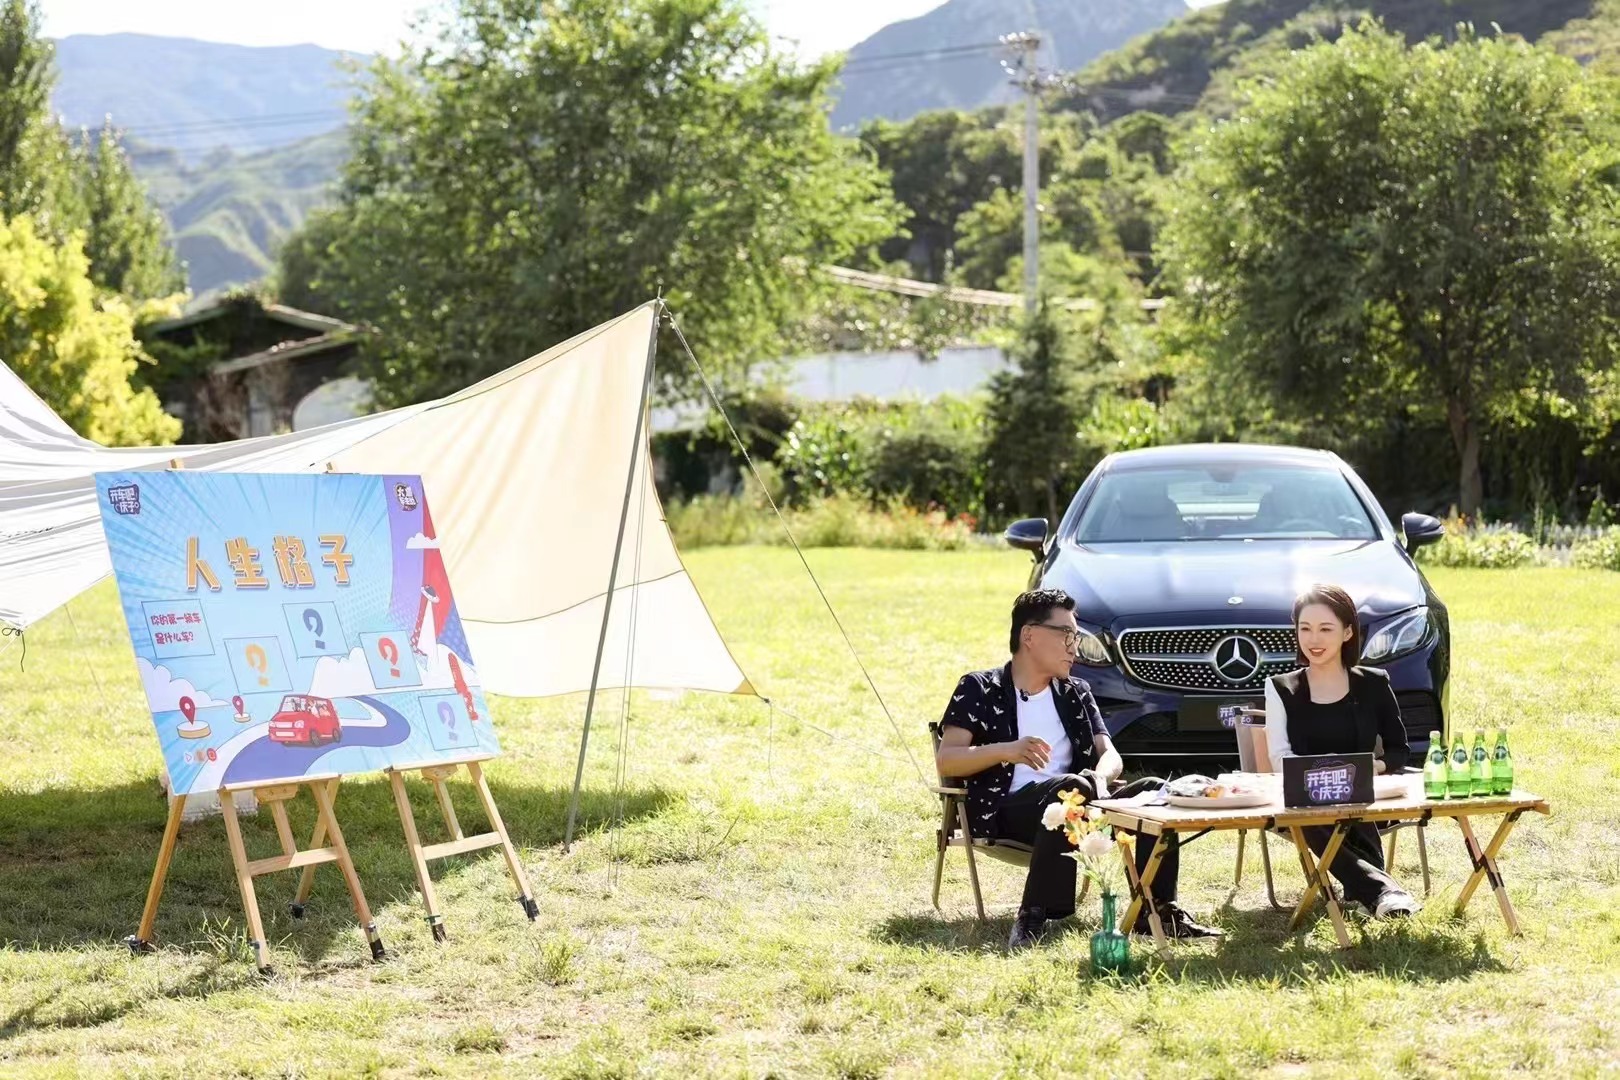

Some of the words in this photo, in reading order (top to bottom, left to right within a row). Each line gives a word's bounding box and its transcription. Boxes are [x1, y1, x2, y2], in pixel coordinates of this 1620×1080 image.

[187, 535, 352, 591] 人生格子
[1307, 768, 1348, 788] 开车吧
